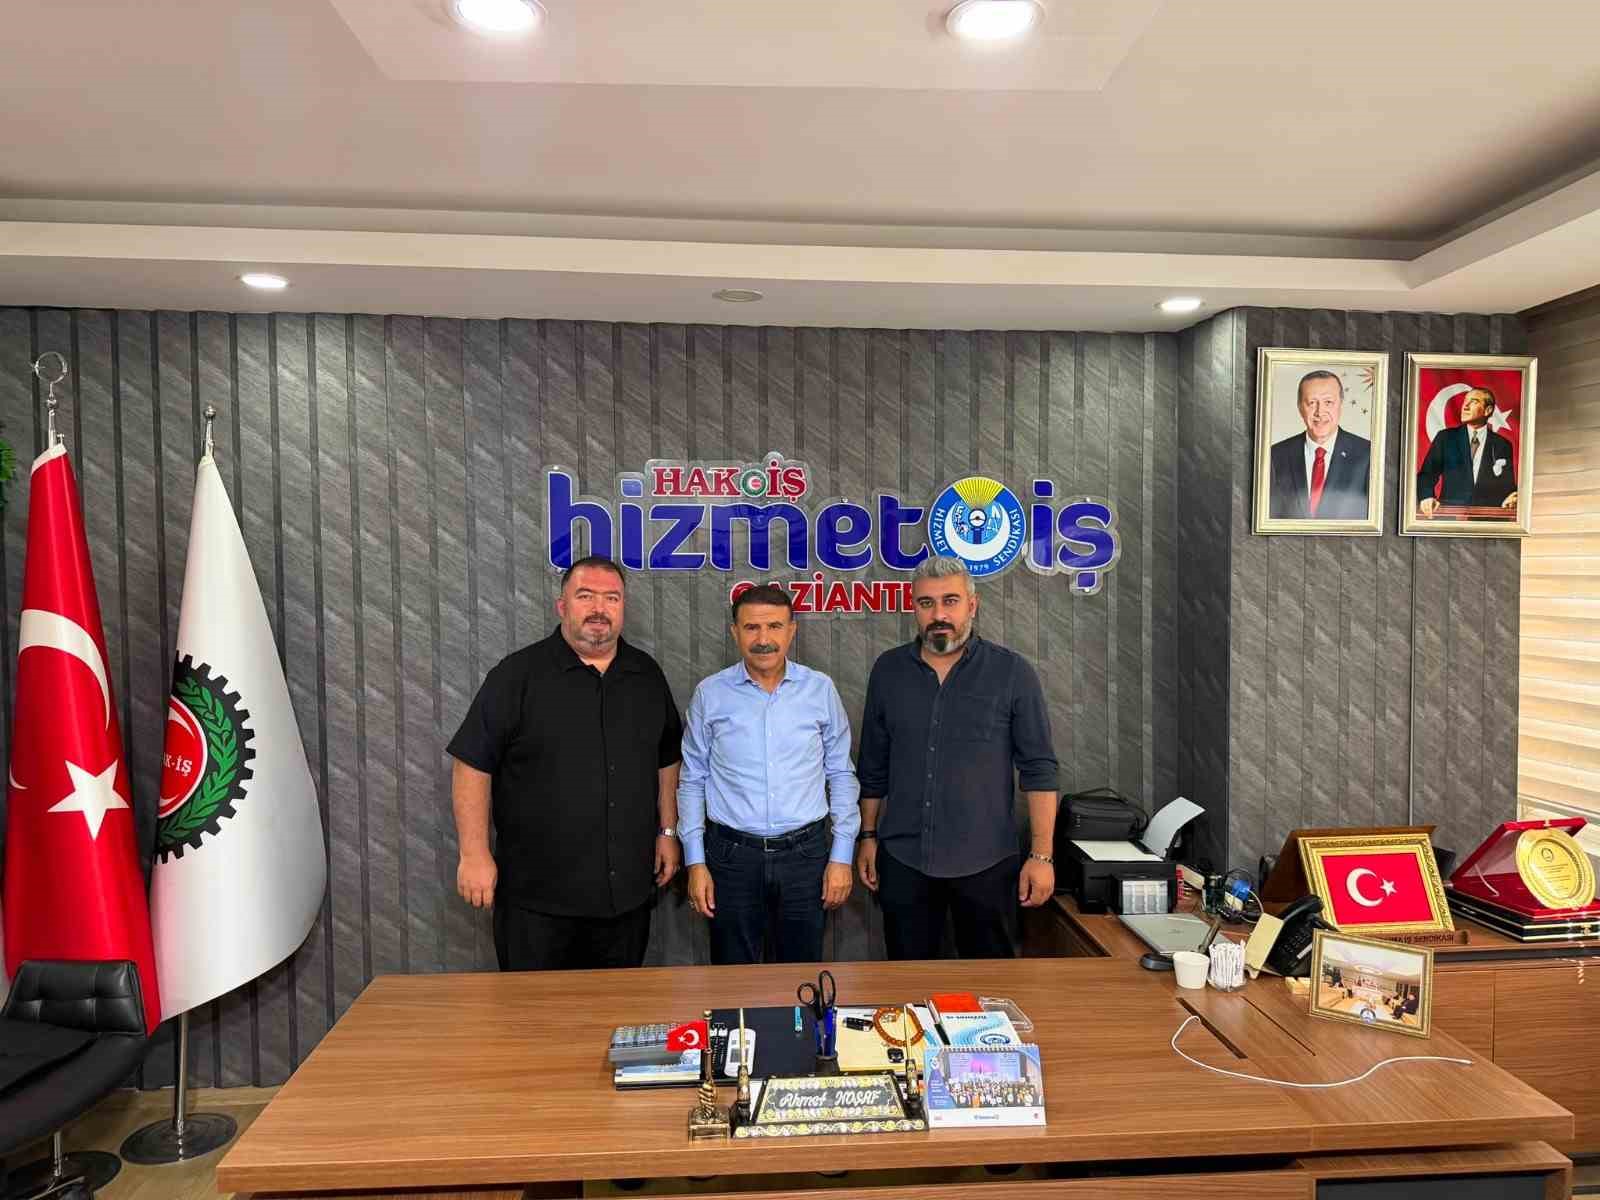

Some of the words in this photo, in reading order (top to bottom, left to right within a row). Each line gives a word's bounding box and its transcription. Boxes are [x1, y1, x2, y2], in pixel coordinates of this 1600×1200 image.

[651, 466, 741, 497] HAK
[766, 459, 807, 503] İŞ
[548, 471, 930, 570] hizmet
[1029, 479, 1115, 593] iş
[778, 1092, 828, 1108] Ahmet
